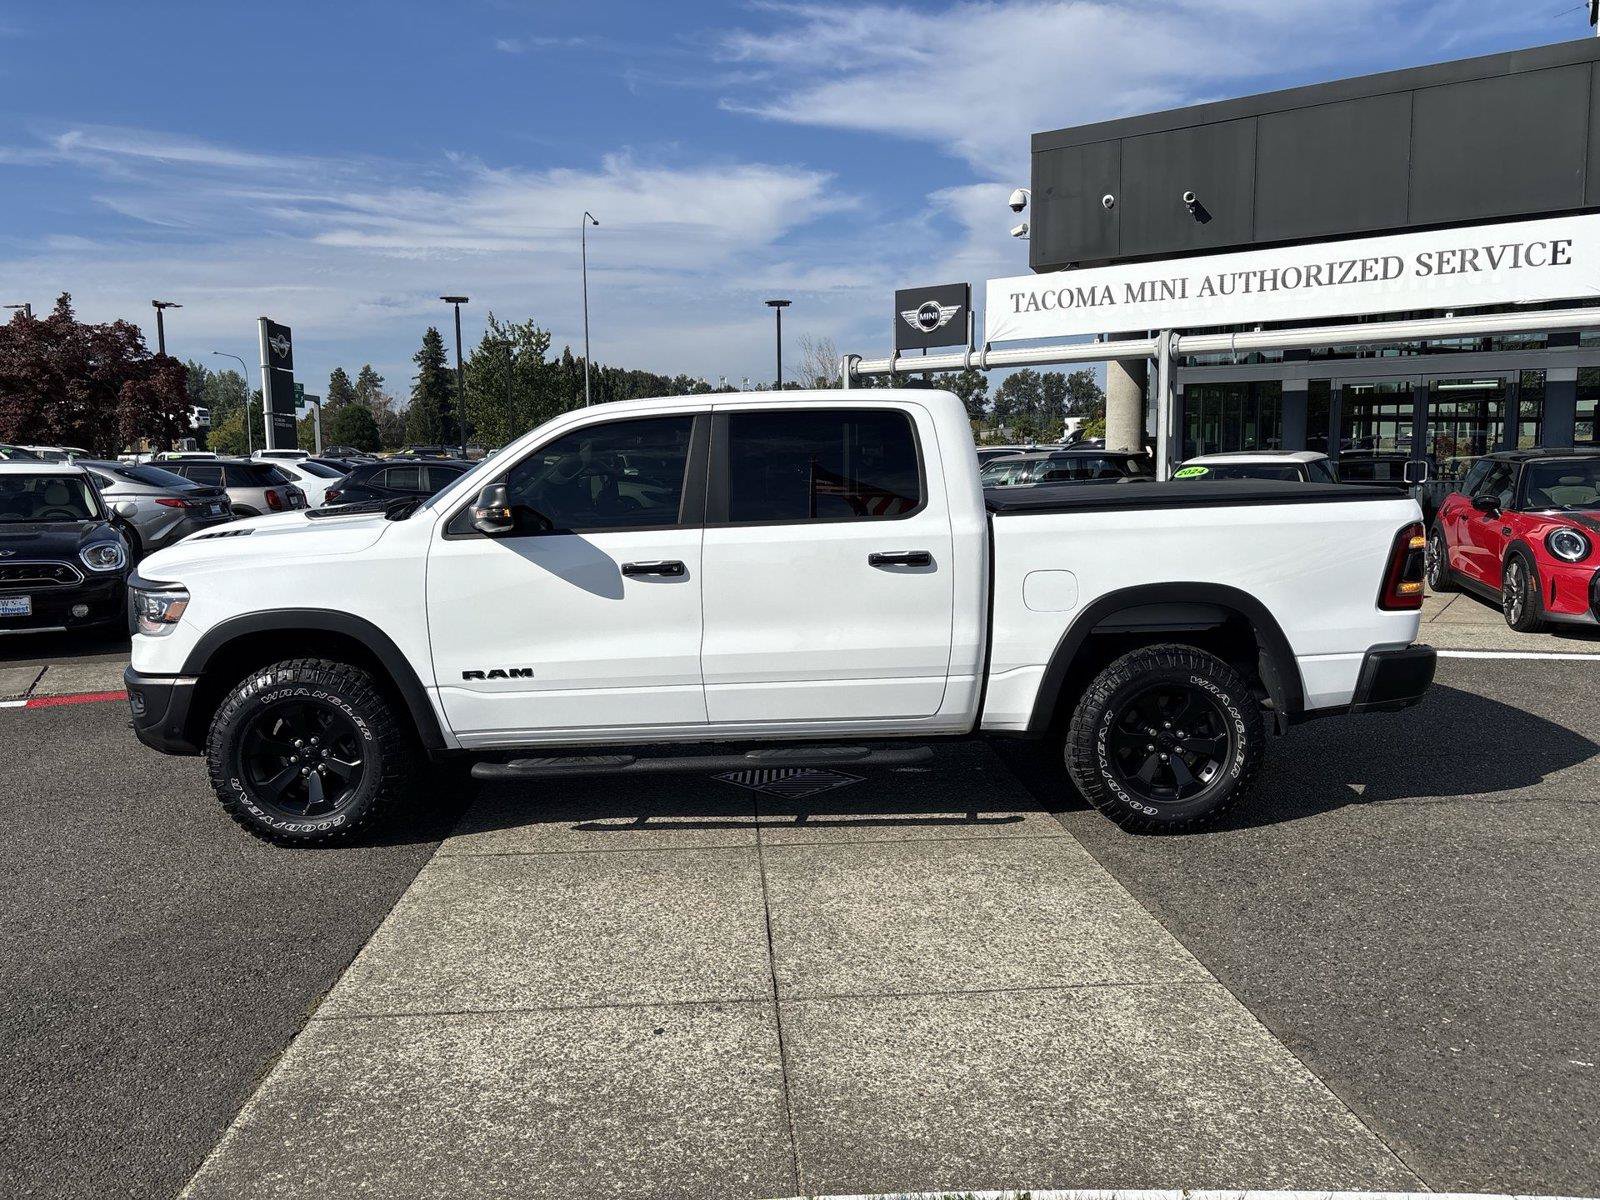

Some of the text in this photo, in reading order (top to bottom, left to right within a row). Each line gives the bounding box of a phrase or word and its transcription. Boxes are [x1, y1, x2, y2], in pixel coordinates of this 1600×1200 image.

[1010, 239, 1573, 313] TACOMA MINI AUTHORIZED SERVICE
[919, 312, 938, 320] MINI
[461, 667, 535, 681] RAM
[260, 687, 373, 741] WRANGLER
[1189, 675, 1246, 779] WRANGLER
[1097, 709, 1159, 816] GOODYEAR
[230, 777, 346, 833] GOODYEAR
